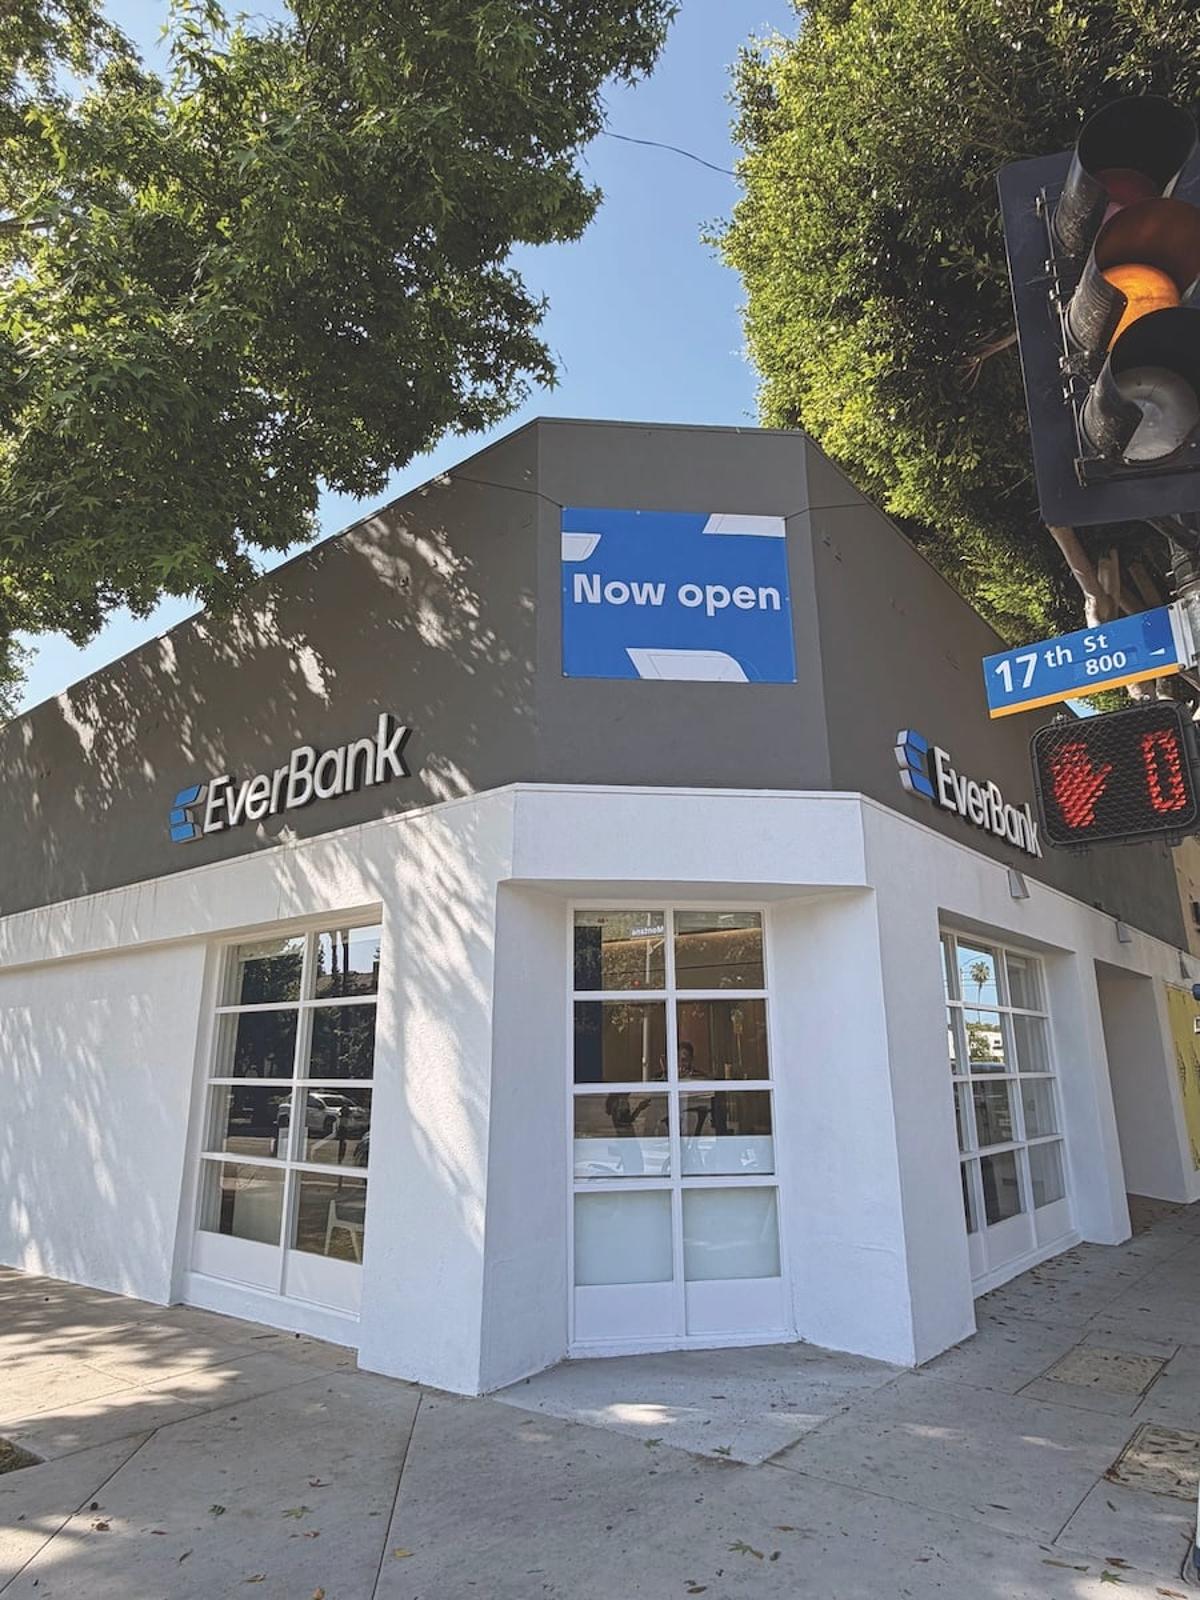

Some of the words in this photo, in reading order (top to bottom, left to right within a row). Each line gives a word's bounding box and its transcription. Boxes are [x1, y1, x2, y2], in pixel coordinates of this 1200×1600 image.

[573, 574, 666, 606] Now
[678, 583, 781, 616] open
[1083, 633, 1108, 653] St
[1085, 651, 1127, 676] 800
[203, 712, 407, 833] EverBank
[934, 745, 1043, 858] EverBank
[1142, 729, 1186, 812] 0
